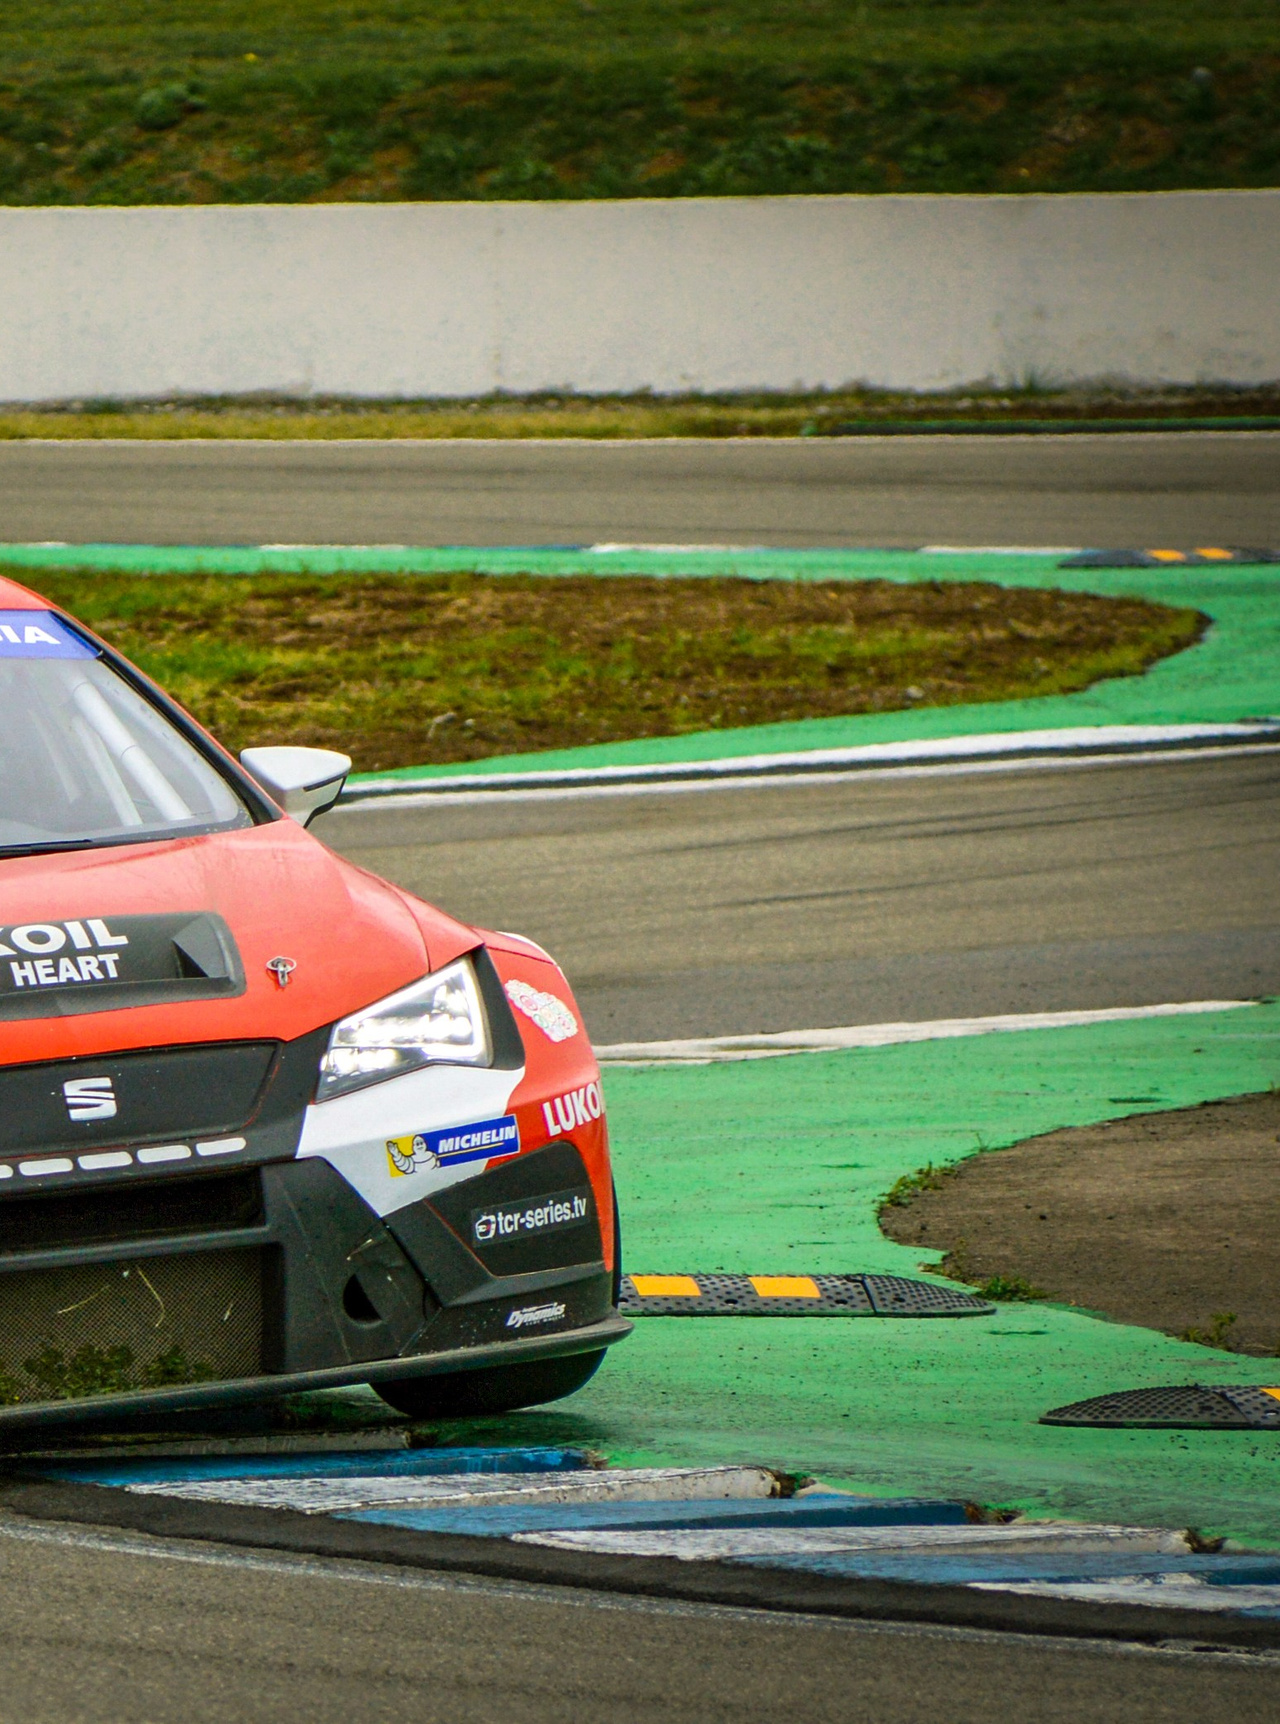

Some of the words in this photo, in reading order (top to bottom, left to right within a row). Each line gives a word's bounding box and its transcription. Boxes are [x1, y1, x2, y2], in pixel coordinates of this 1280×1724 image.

[13, 952, 121, 987] HEART
[437, 1124, 518, 1154] MICHELIN
[497, 1195, 588, 1235] tcr-series.tv
